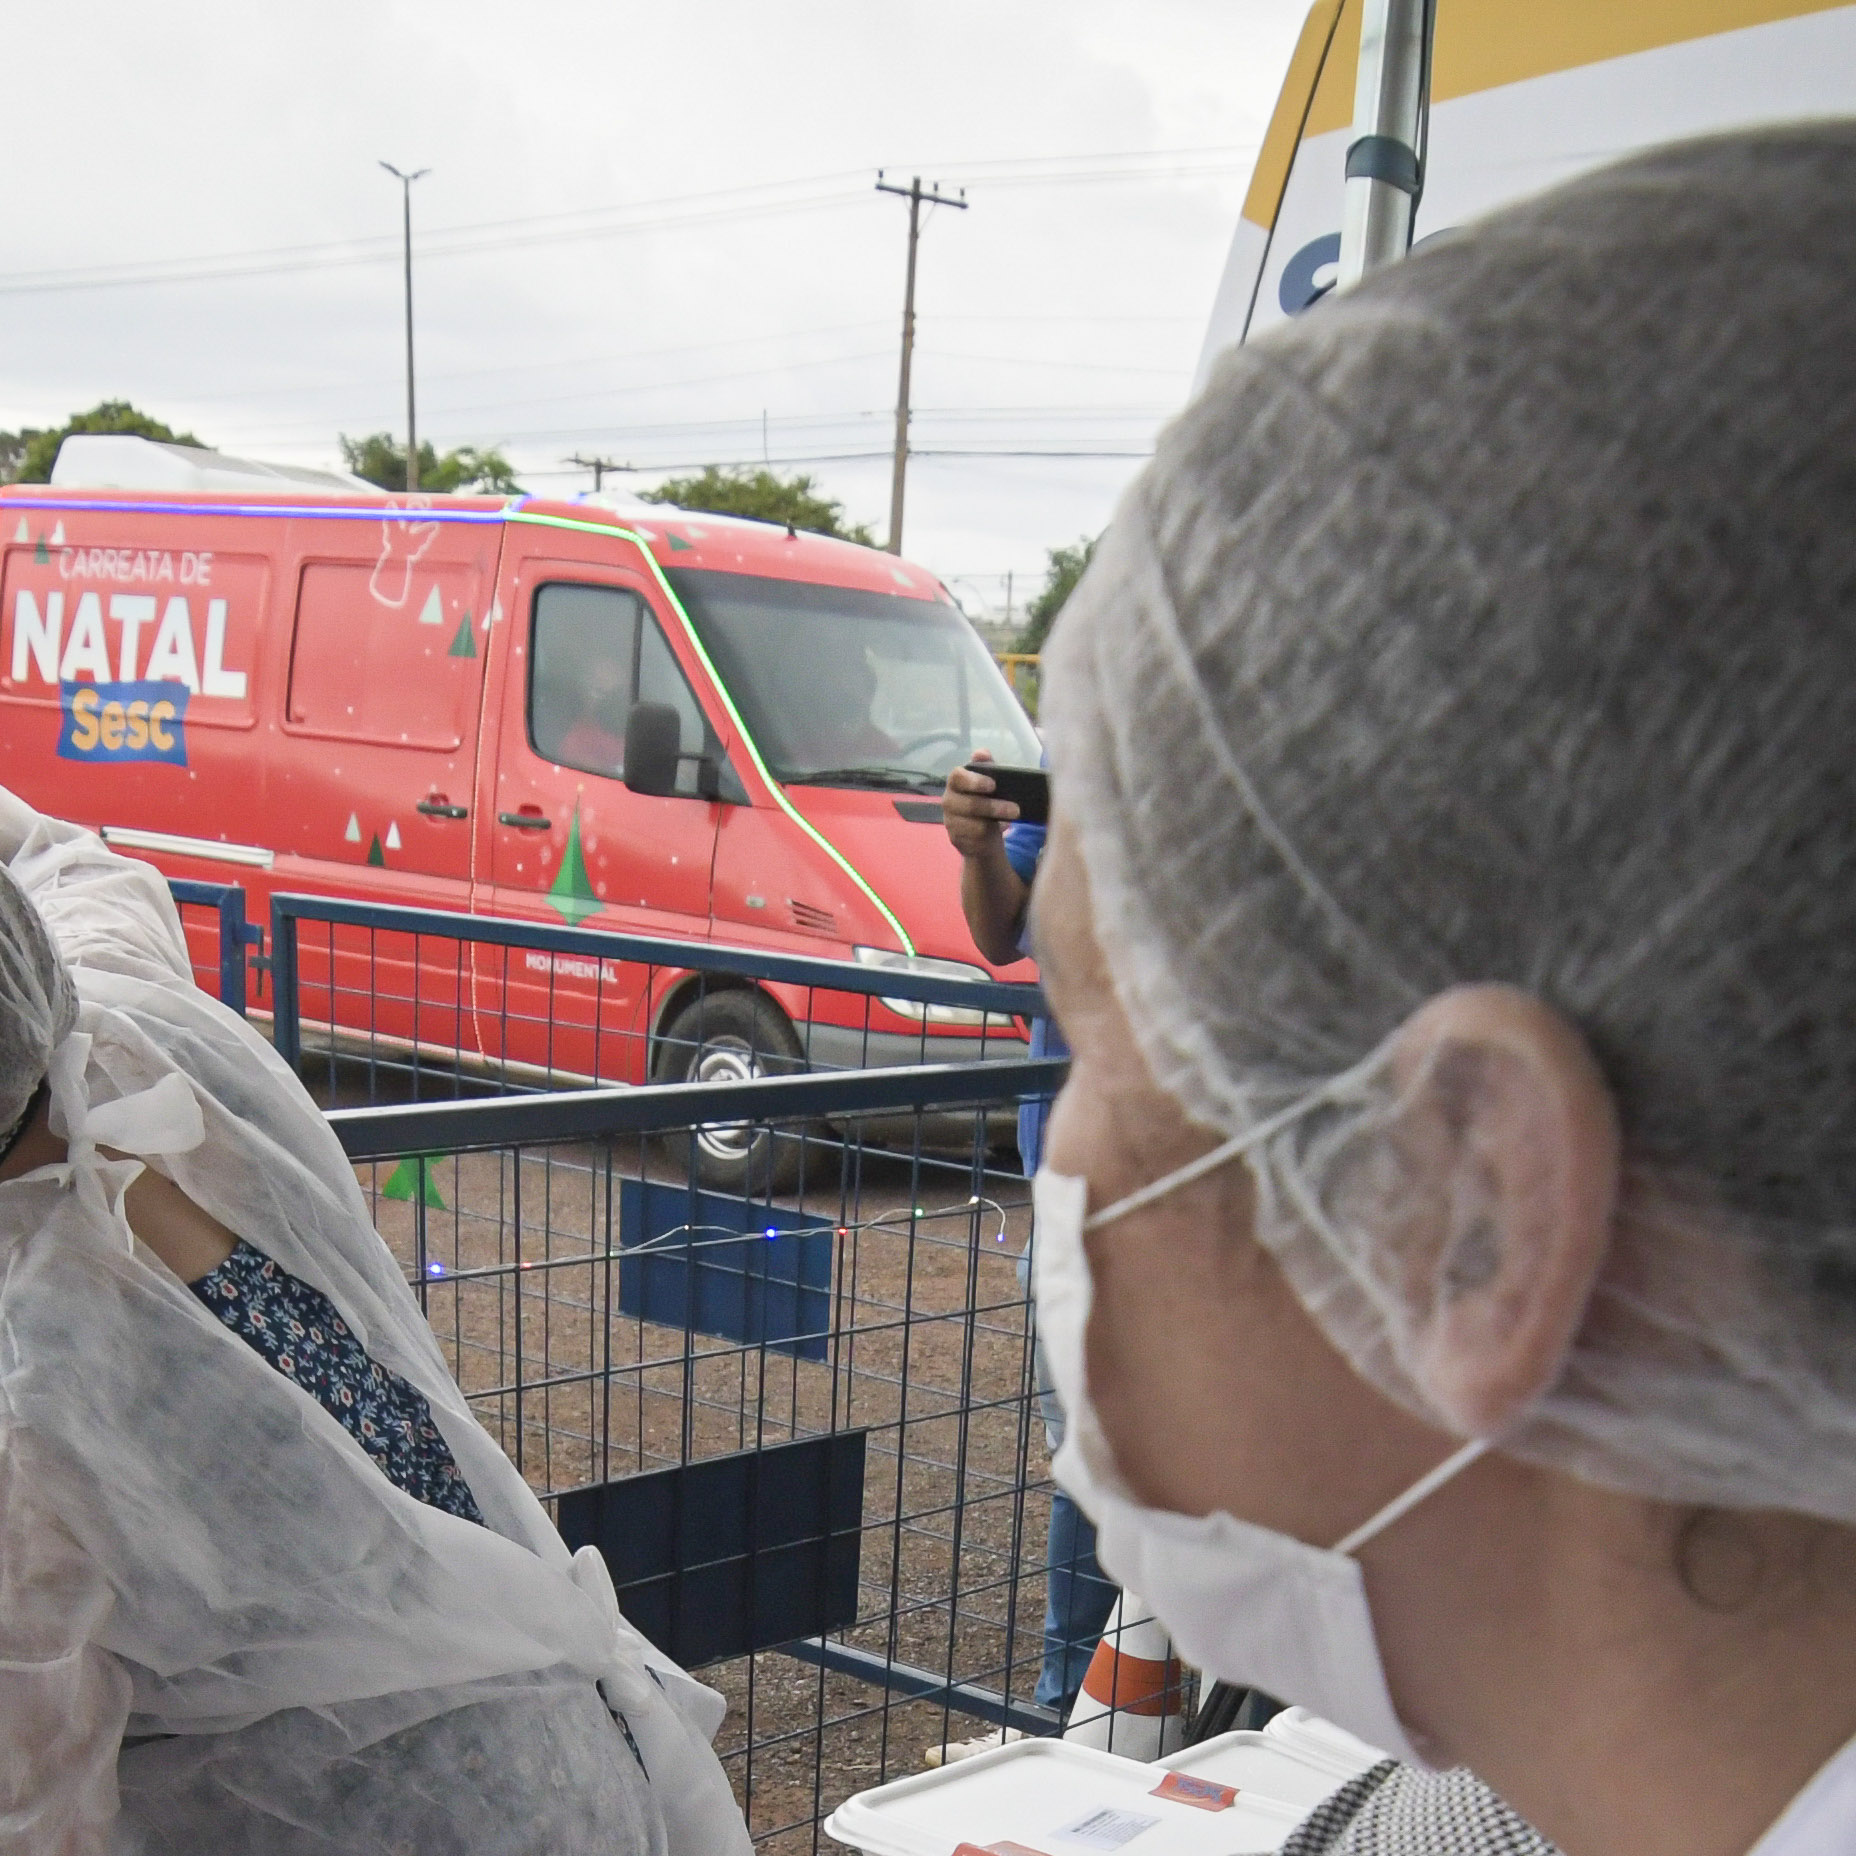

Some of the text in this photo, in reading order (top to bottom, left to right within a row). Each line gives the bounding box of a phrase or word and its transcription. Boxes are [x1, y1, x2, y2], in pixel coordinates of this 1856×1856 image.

[59, 548, 212, 585] CARREATA DE
[11, 590, 247, 698] NATAL
[71, 688, 176, 750] Sesc
[526, 952, 618, 983] MONUMENTAL
